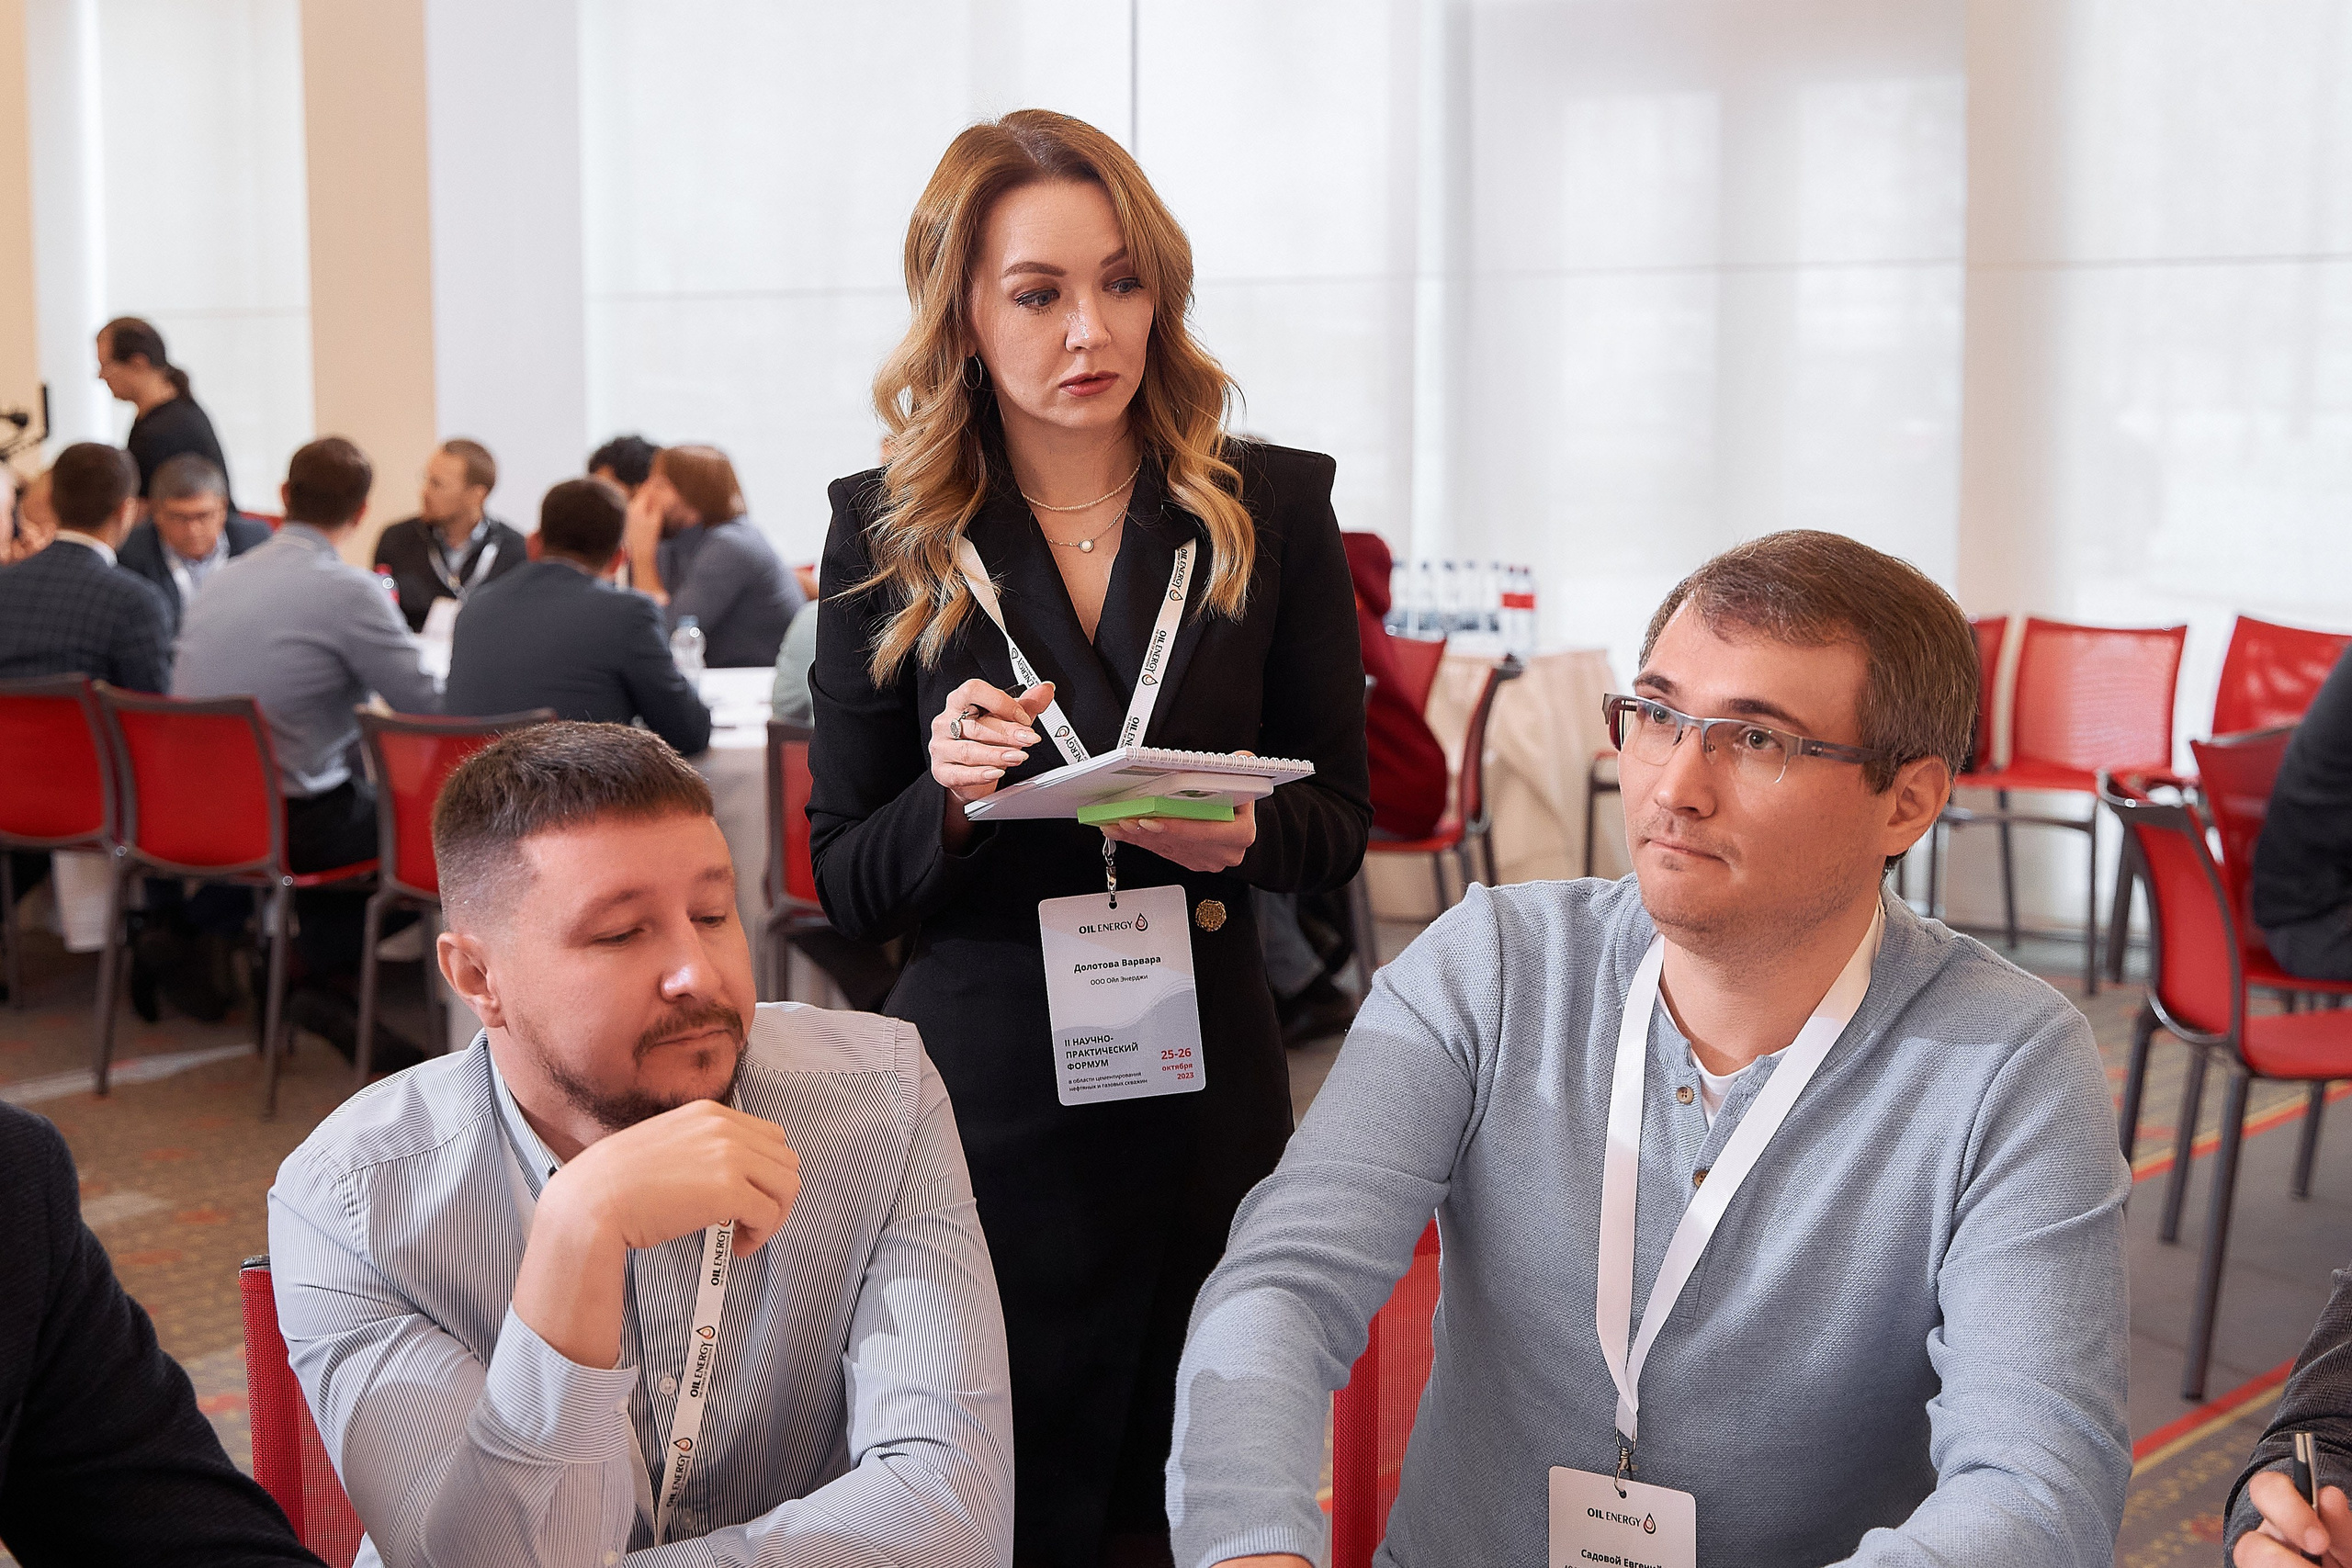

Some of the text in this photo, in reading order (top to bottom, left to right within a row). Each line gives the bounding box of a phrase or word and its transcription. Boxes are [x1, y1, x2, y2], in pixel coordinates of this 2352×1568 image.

[1171, 560, 1187, 591] ENERGY
[1145, 630, 1167, 674] OIL ENERGY
[1017, 657, 1035, 687] ENERGY
[1125, 716, 1140, 747] OIL ENE
[1064, 736, 1084, 762] NERGY
[1079, 920, 1133, 934] OIL ENERGY
[1074, 956, 1161, 974] Долотова Варвара
[1120, 974, 1148, 983] Энерджи
[1066, 1042, 1139, 1059] ПРАКТИЧЕСКИЙ
[1072, 1034, 1114, 1046] НАУЧНО-
[1160, 1047, 1192, 1060] 25-26
[1161, 1063, 1193, 1072] октября
[711, 1229, 730, 1286] OIL ENERGY
[690, 1341, 714, 1397] OIL ENERGY
[672, 1453, 691, 1490] ENERGY
[1588, 1507, 1642, 1528] OIL ENERGY
[1581, 1549, 1622, 1565] Садовой
